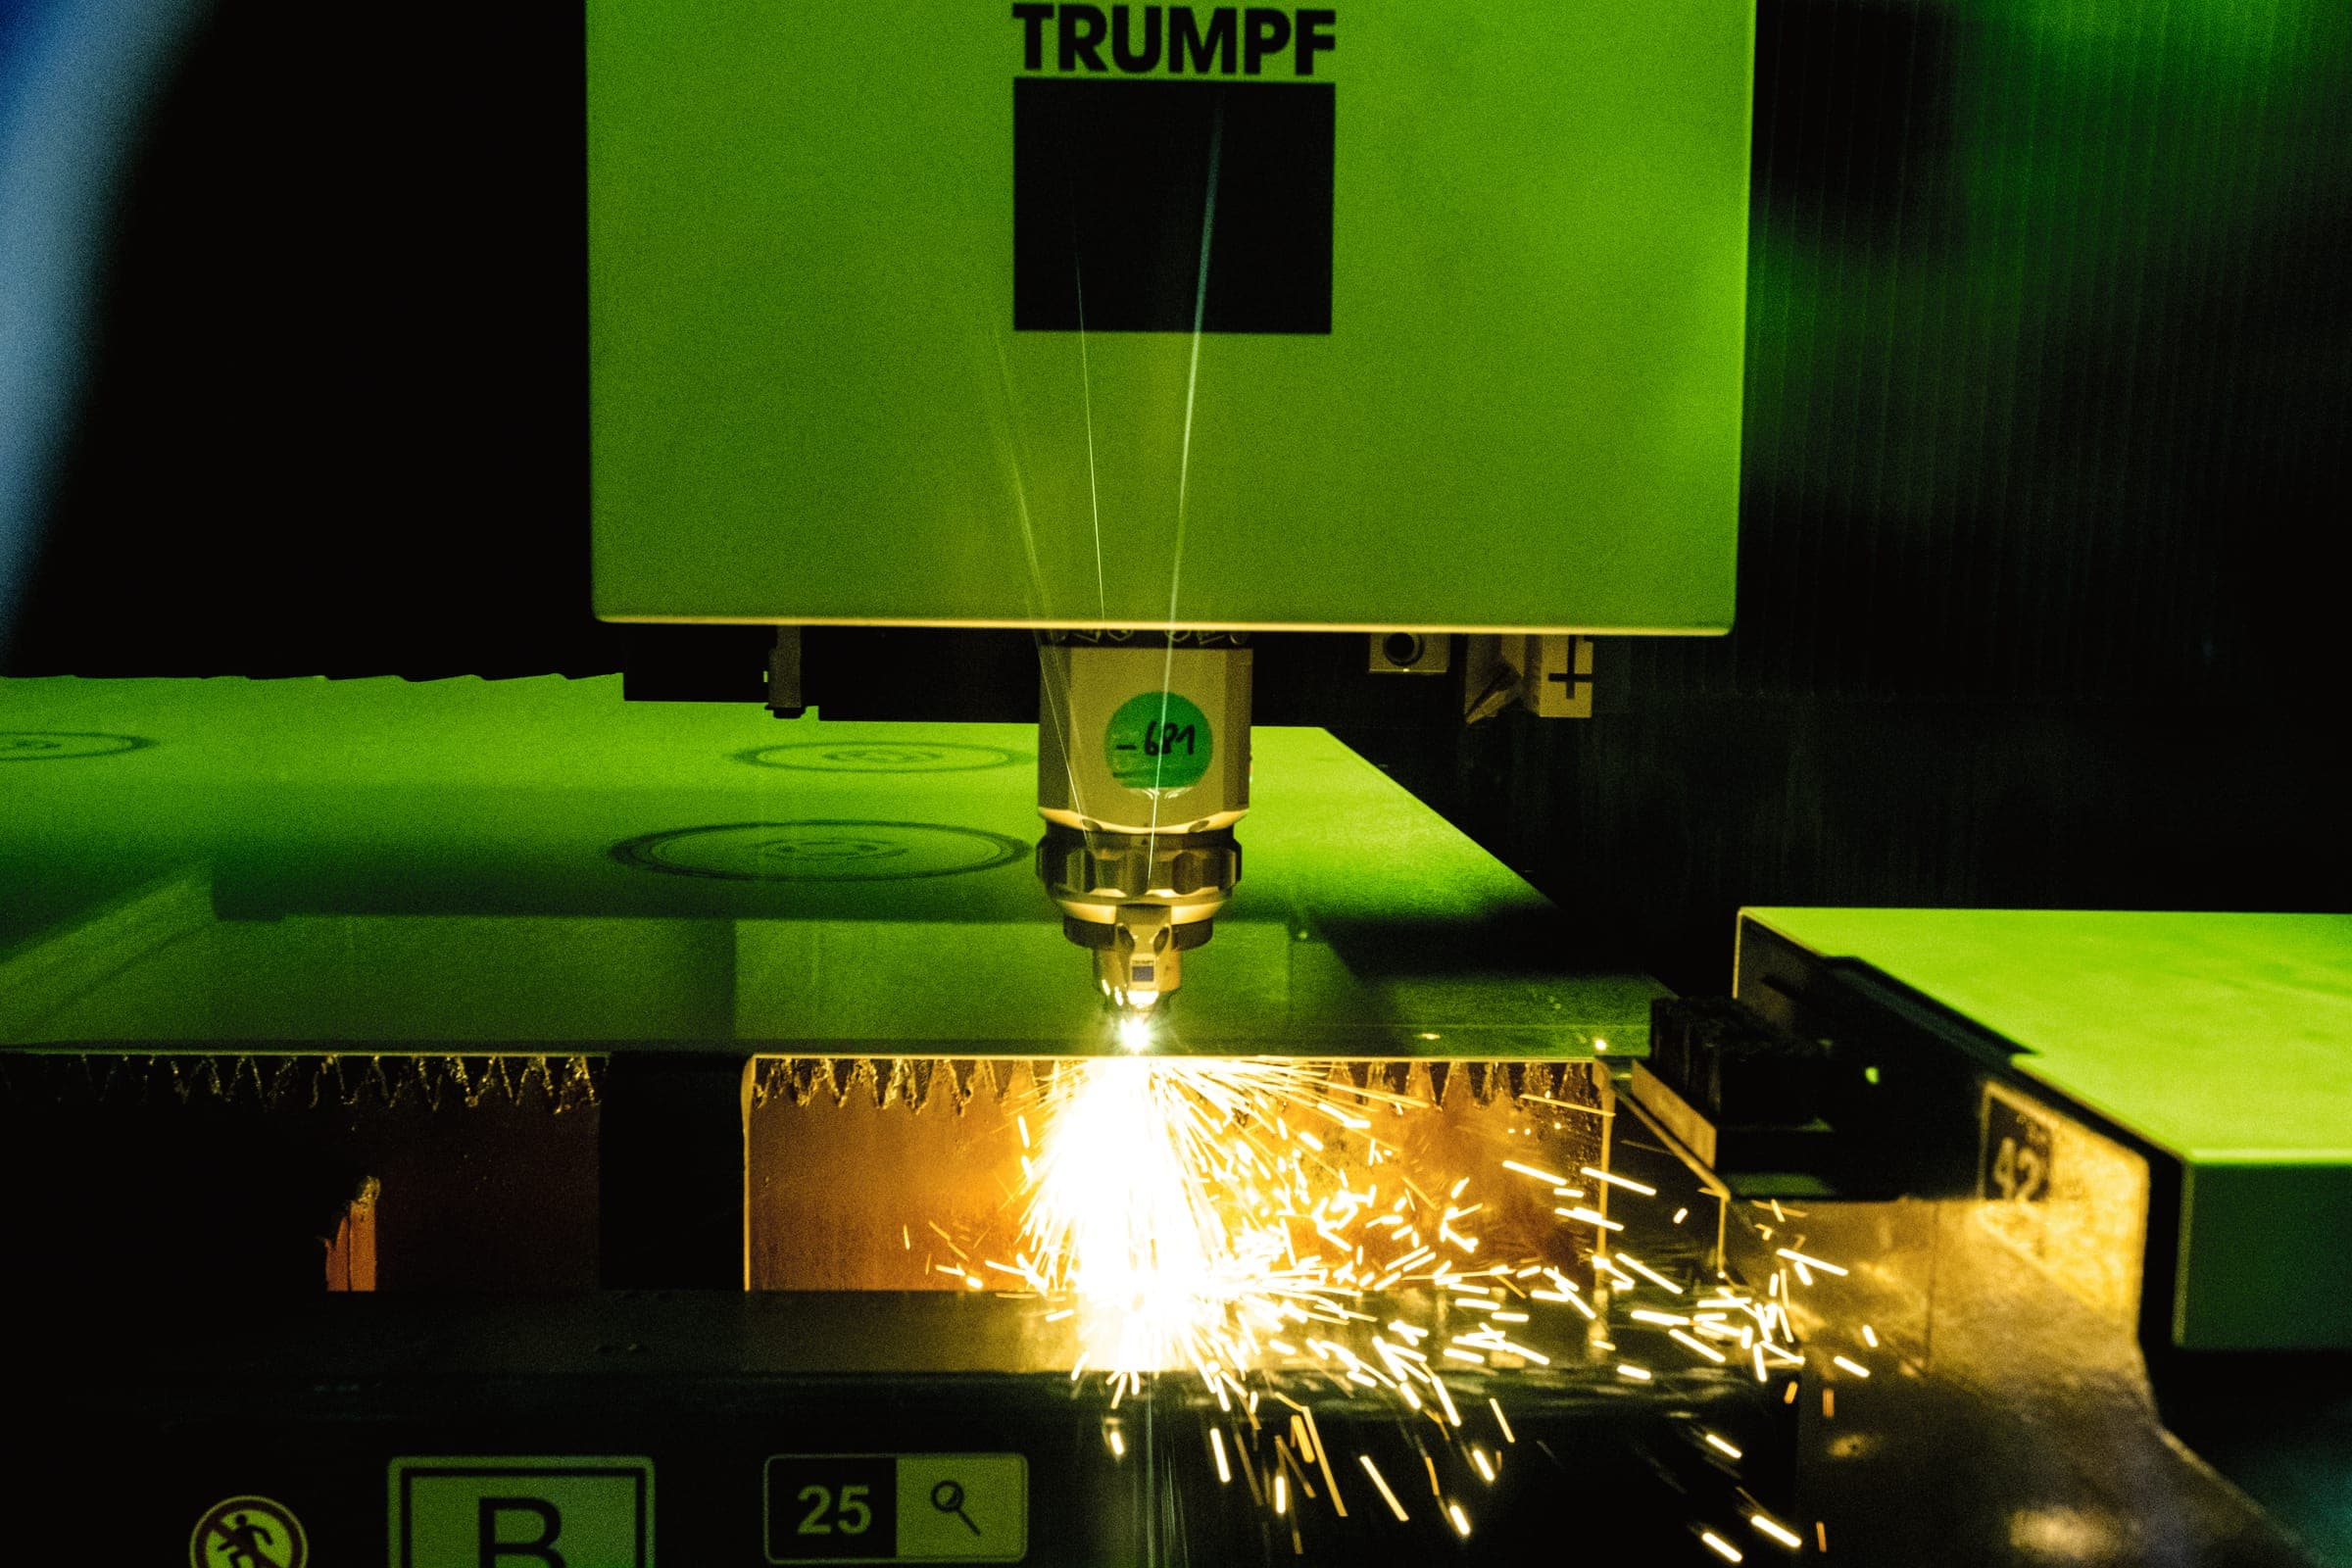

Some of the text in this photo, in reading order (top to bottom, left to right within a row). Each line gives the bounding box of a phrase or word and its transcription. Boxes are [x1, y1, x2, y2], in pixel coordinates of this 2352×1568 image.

[1012, 3, 1336, 75] TRUMPF
[479, 1497, 565, 1568] B
[797, 1484, 872, 1536] 25
